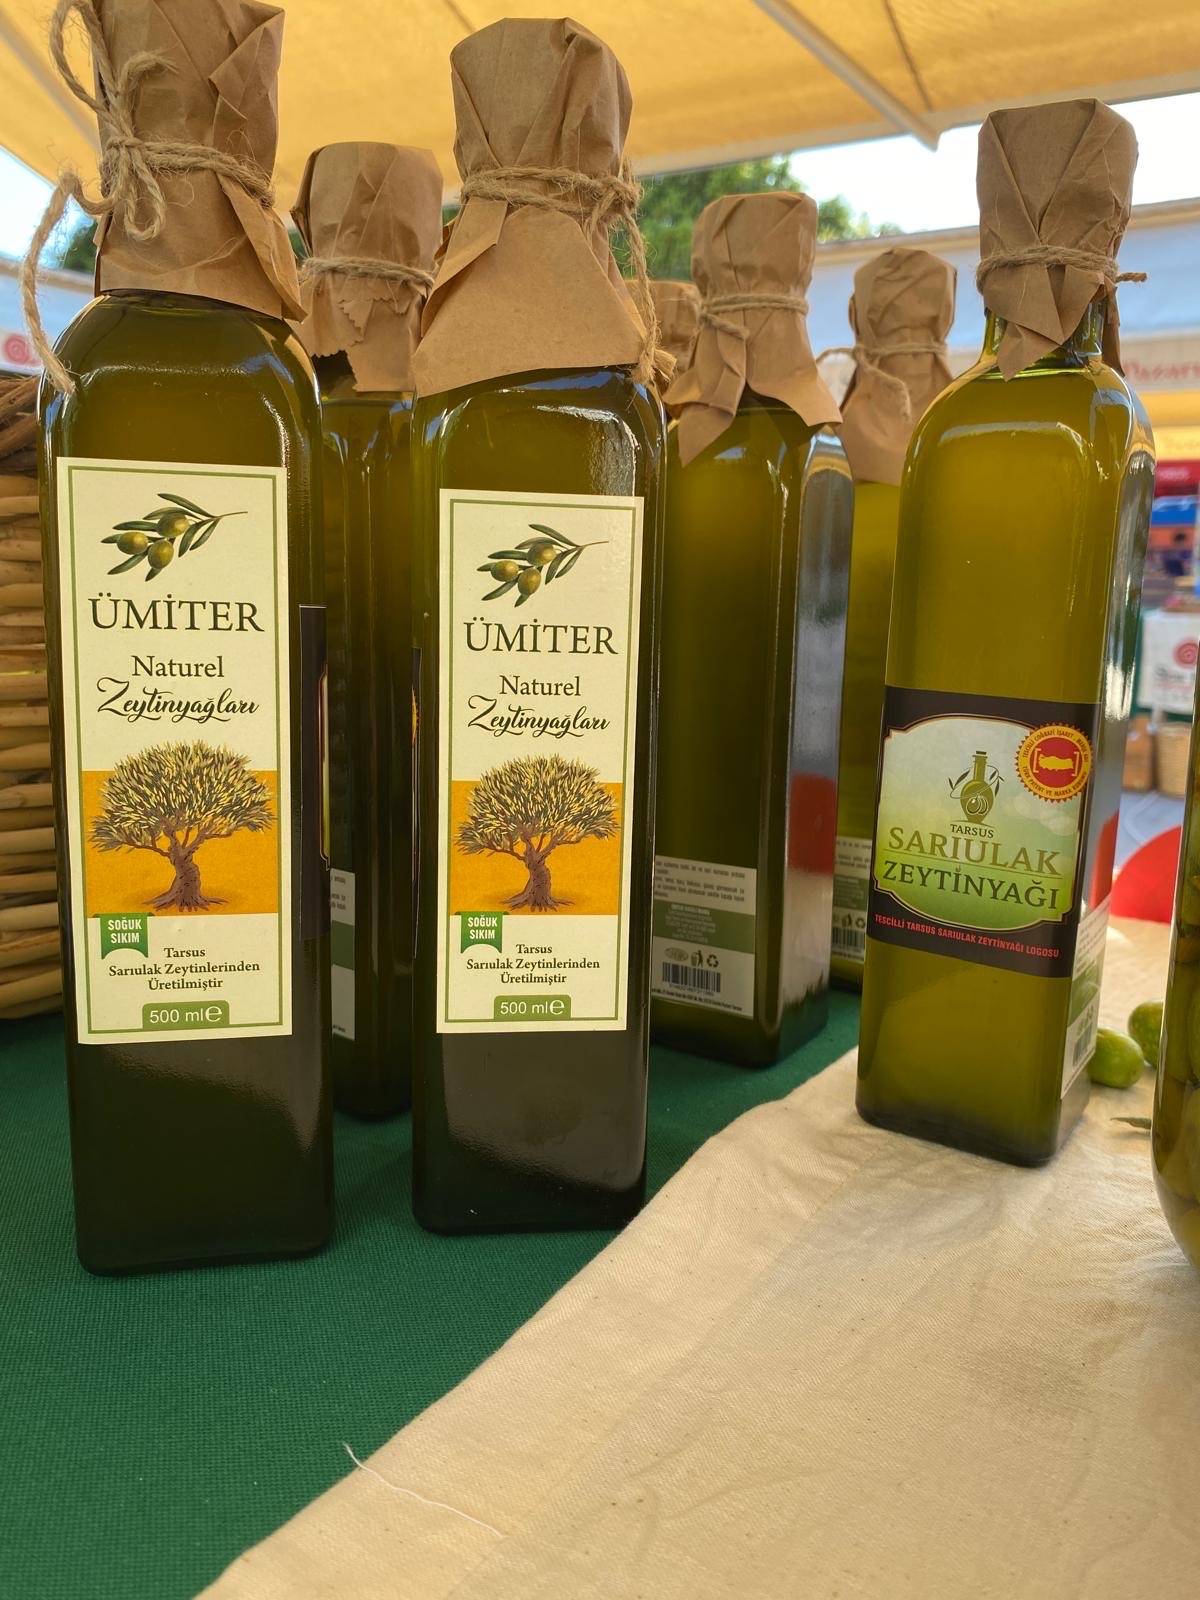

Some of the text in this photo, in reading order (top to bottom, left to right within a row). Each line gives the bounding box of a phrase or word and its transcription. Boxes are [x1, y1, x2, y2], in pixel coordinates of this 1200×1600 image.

[87, 592, 265, 632] ÜMİTER
[463, 616, 619, 655] ÜMİTER
[131, 655, 225, 678] Naturel
[499, 675, 581, 696] Naturel
[96, 677, 259, 724] Zeytinyağları
[467, 694, 611, 739] Zeytinyağları
[951, 823, 994, 839] TARSUS
[888, 827, 1061, 876] SARIULAK
[882, 860, 1060, 910] ZEYTİNYAĞI
[108, 916, 142, 930] SOĞUK
[467, 914, 498, 927] SOĞUK
[110, 932, 140, 943] SIKIM
[469, 929, 496, 940] SIKIM
[875, 914, 906, 929] TESCİLLİ
[907, 921, 936, 936] TARSUS
[937, 927, 977, 944] SARIULAK
[1026, 944, 1060, 958] LOGOSU
[163, 947, 206, 958] Tarsus
[515, 944, 553, 954] Tarsus
[109, 961, 260, 977] Sarıulak Zeytinlerinden
[466, 958, 600, 972] Sarıulak Zeytinlerinden
[148, 977, 223, 991] Üretilmiştir
[500, 973, 567, 986] Üretilmiştir
[500, 1001, 527, 1015] 500
[150, 1009, 179, 1024] 500
